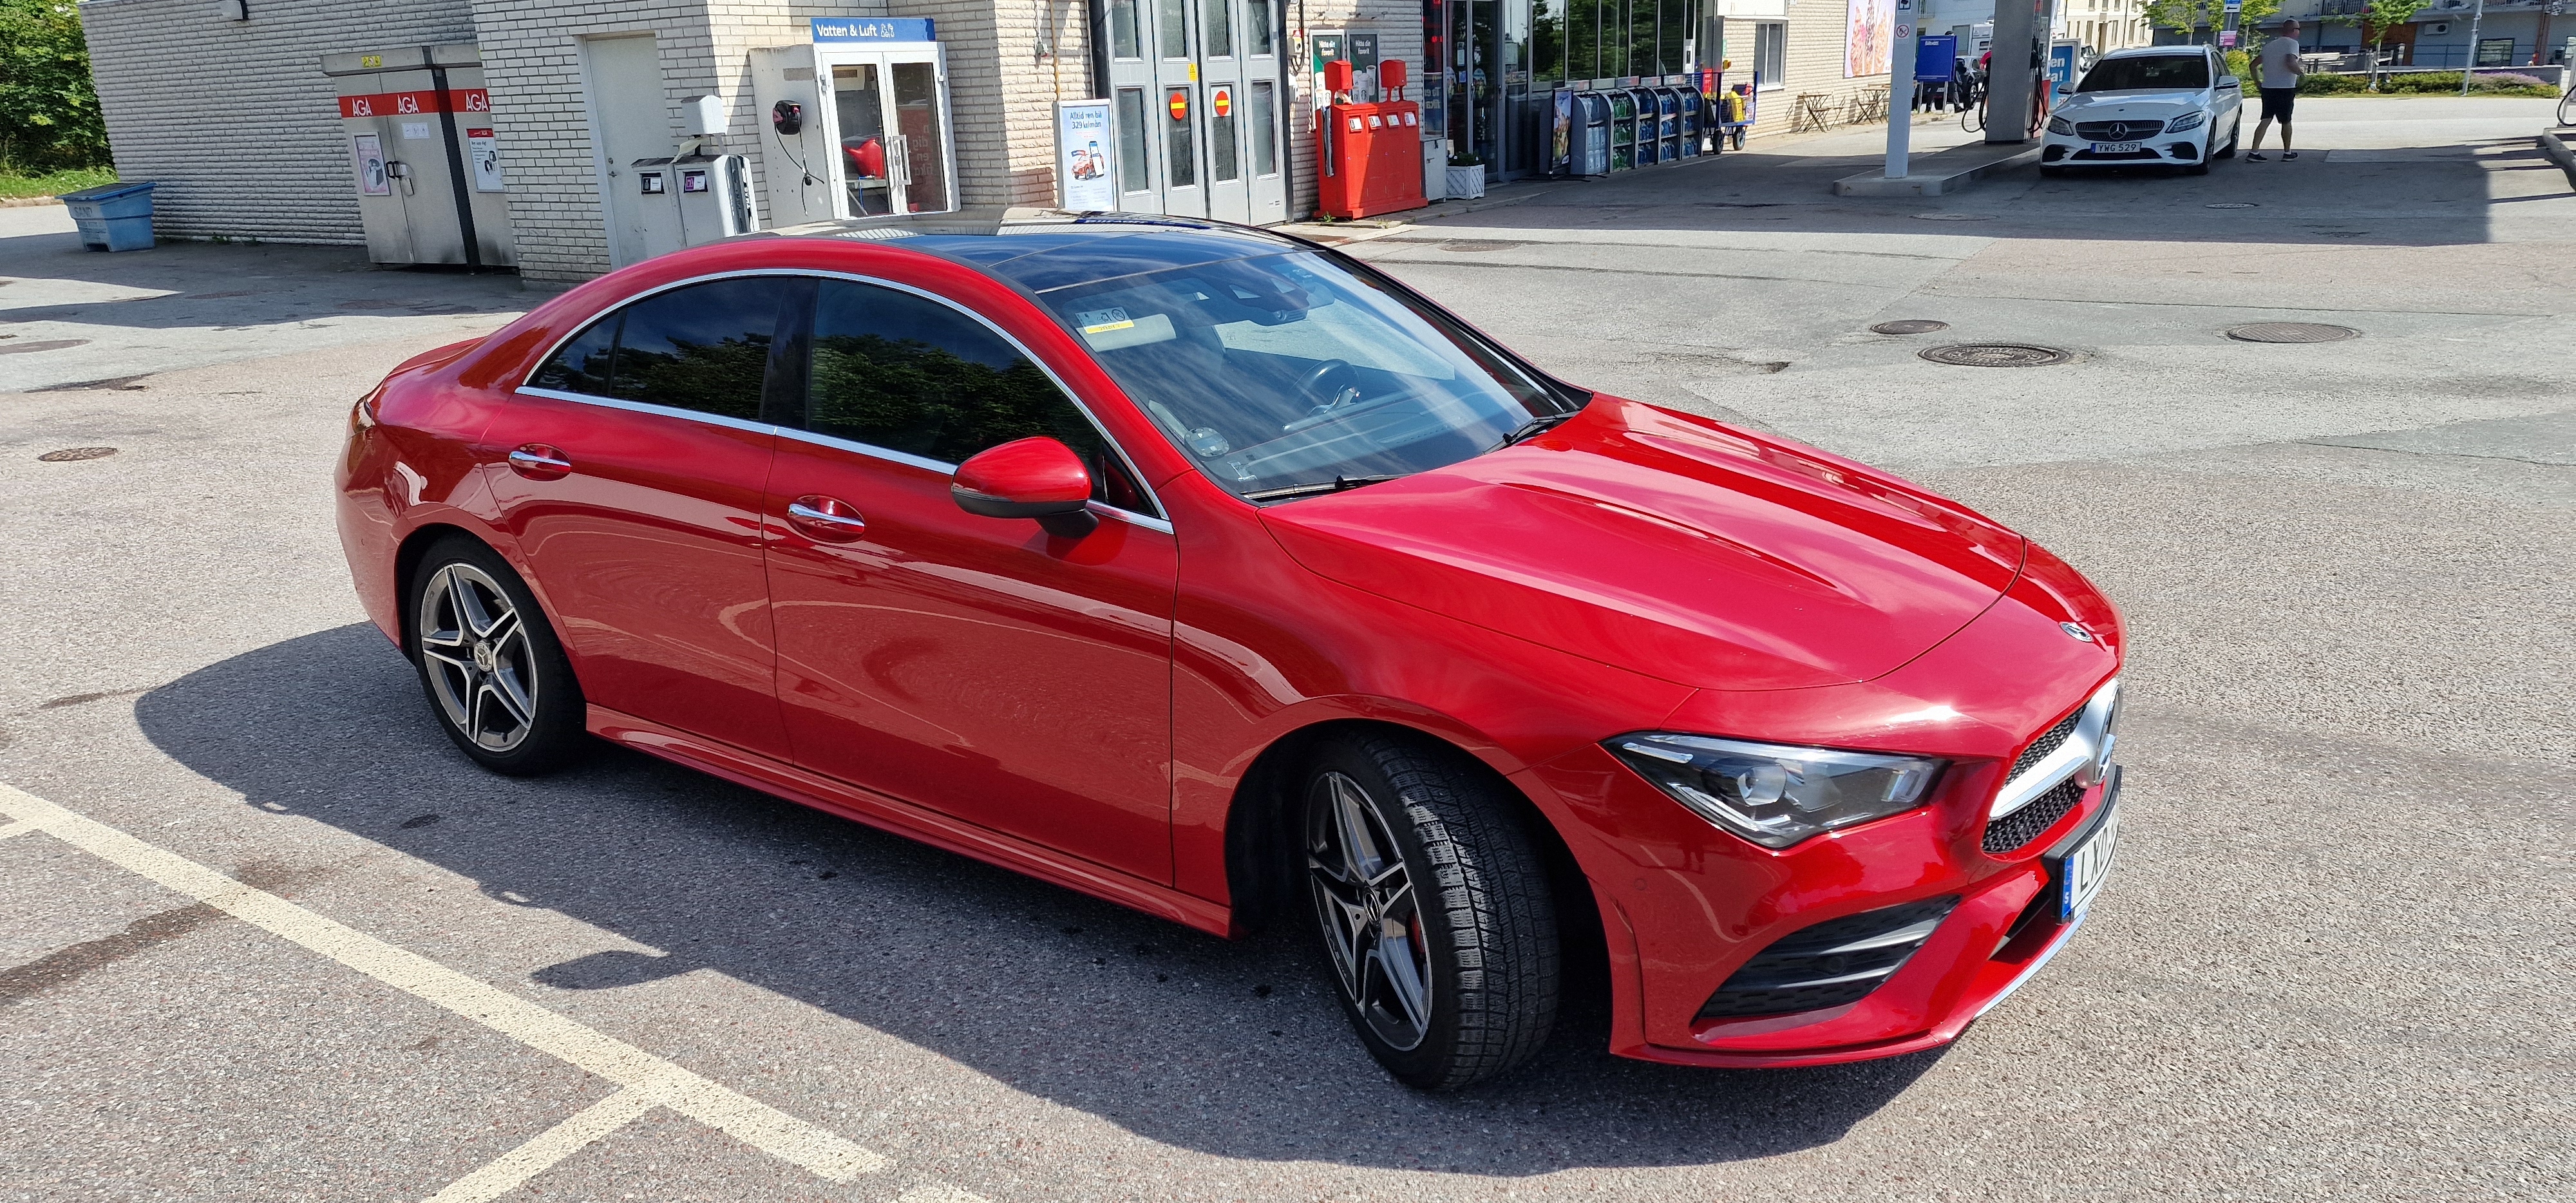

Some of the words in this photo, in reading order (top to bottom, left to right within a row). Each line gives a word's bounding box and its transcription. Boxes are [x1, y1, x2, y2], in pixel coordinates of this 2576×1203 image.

[816, 24, 848, 37] Vatten
[849, 23, 857, 37] &
[859, 23, 878, 37] Luft
[352, 97, 373, 117] AGA
[397, 93, 420, 114] AGA
[466, 90, 489, 112] AGA
[1070, 111, 1084, 120] Alltid
[1072, 121, 1083, 129] 329
[2099, 144, 2116, 152] YWG
[2063, 892, 2070, 905] S
